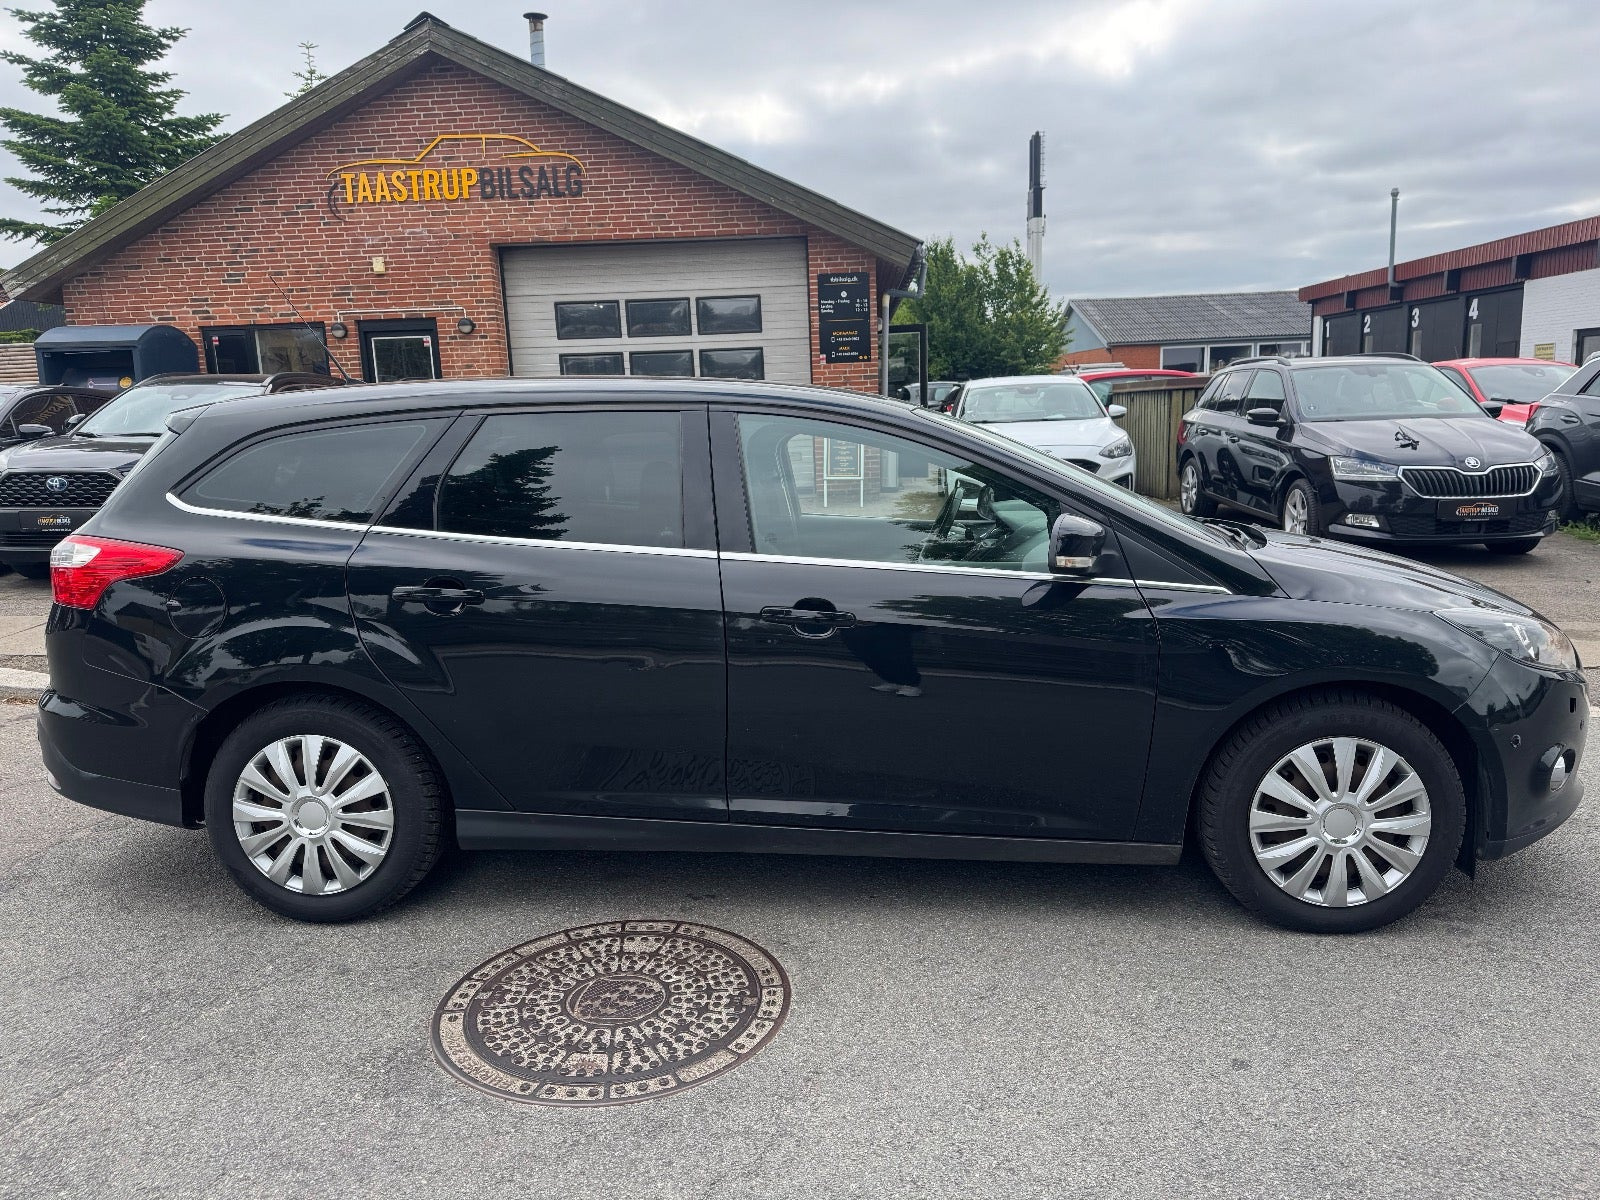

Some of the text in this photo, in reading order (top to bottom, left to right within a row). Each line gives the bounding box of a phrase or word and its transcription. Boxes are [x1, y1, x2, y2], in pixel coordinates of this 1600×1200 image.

[340, 164, 583, 204] TAASTRUP BILSALG
[1411, 307, 1420, 328] 3
[1468, 298, 1479, 320] 4
[1325, 321, 1330, 338] 1
[1363, 315, 1371, 334] 2
